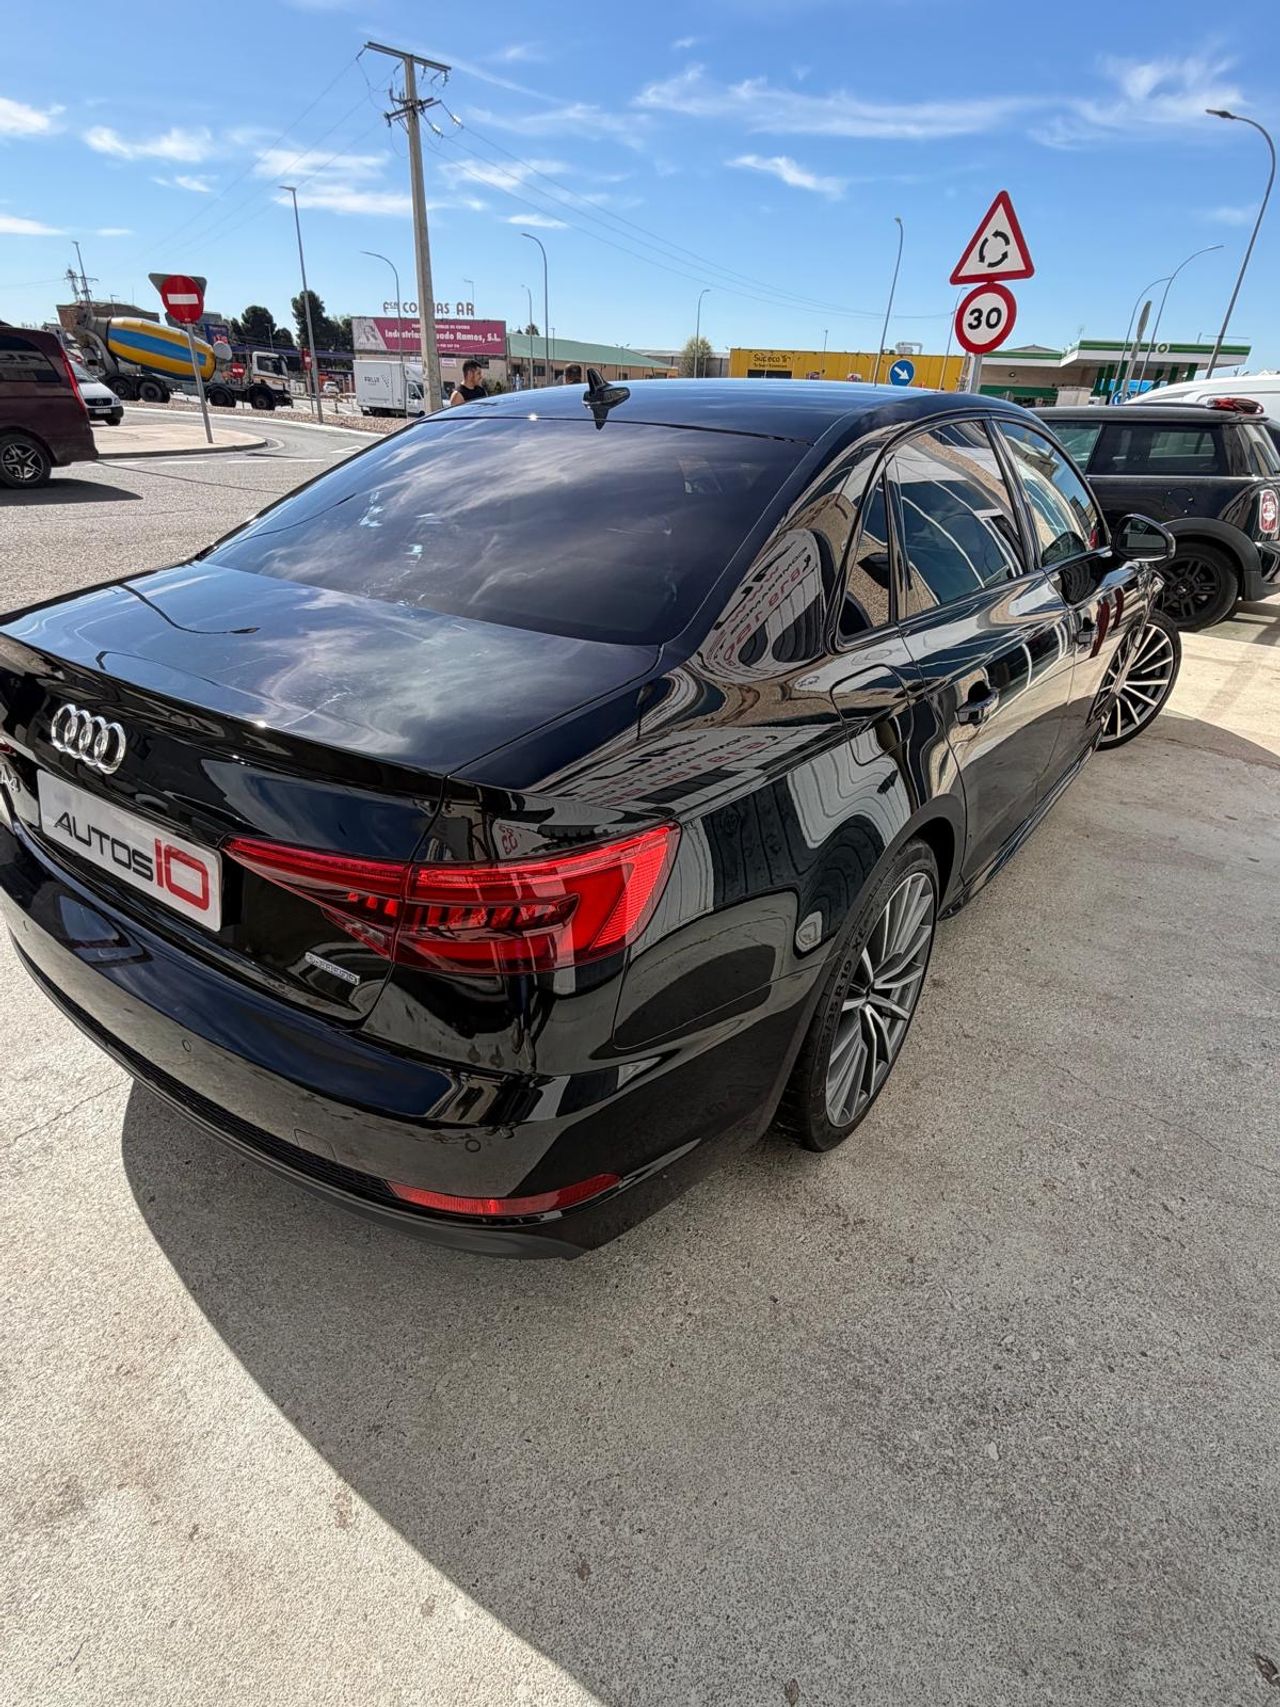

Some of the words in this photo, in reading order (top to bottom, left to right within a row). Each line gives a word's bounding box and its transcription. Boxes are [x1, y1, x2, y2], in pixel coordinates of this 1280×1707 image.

[403, 302, 450, 314] COAS
[456, 302, 474, 316] AR
[967, 307, 1002, 330] 30
[456, 332, 485, 343] Ramos,
